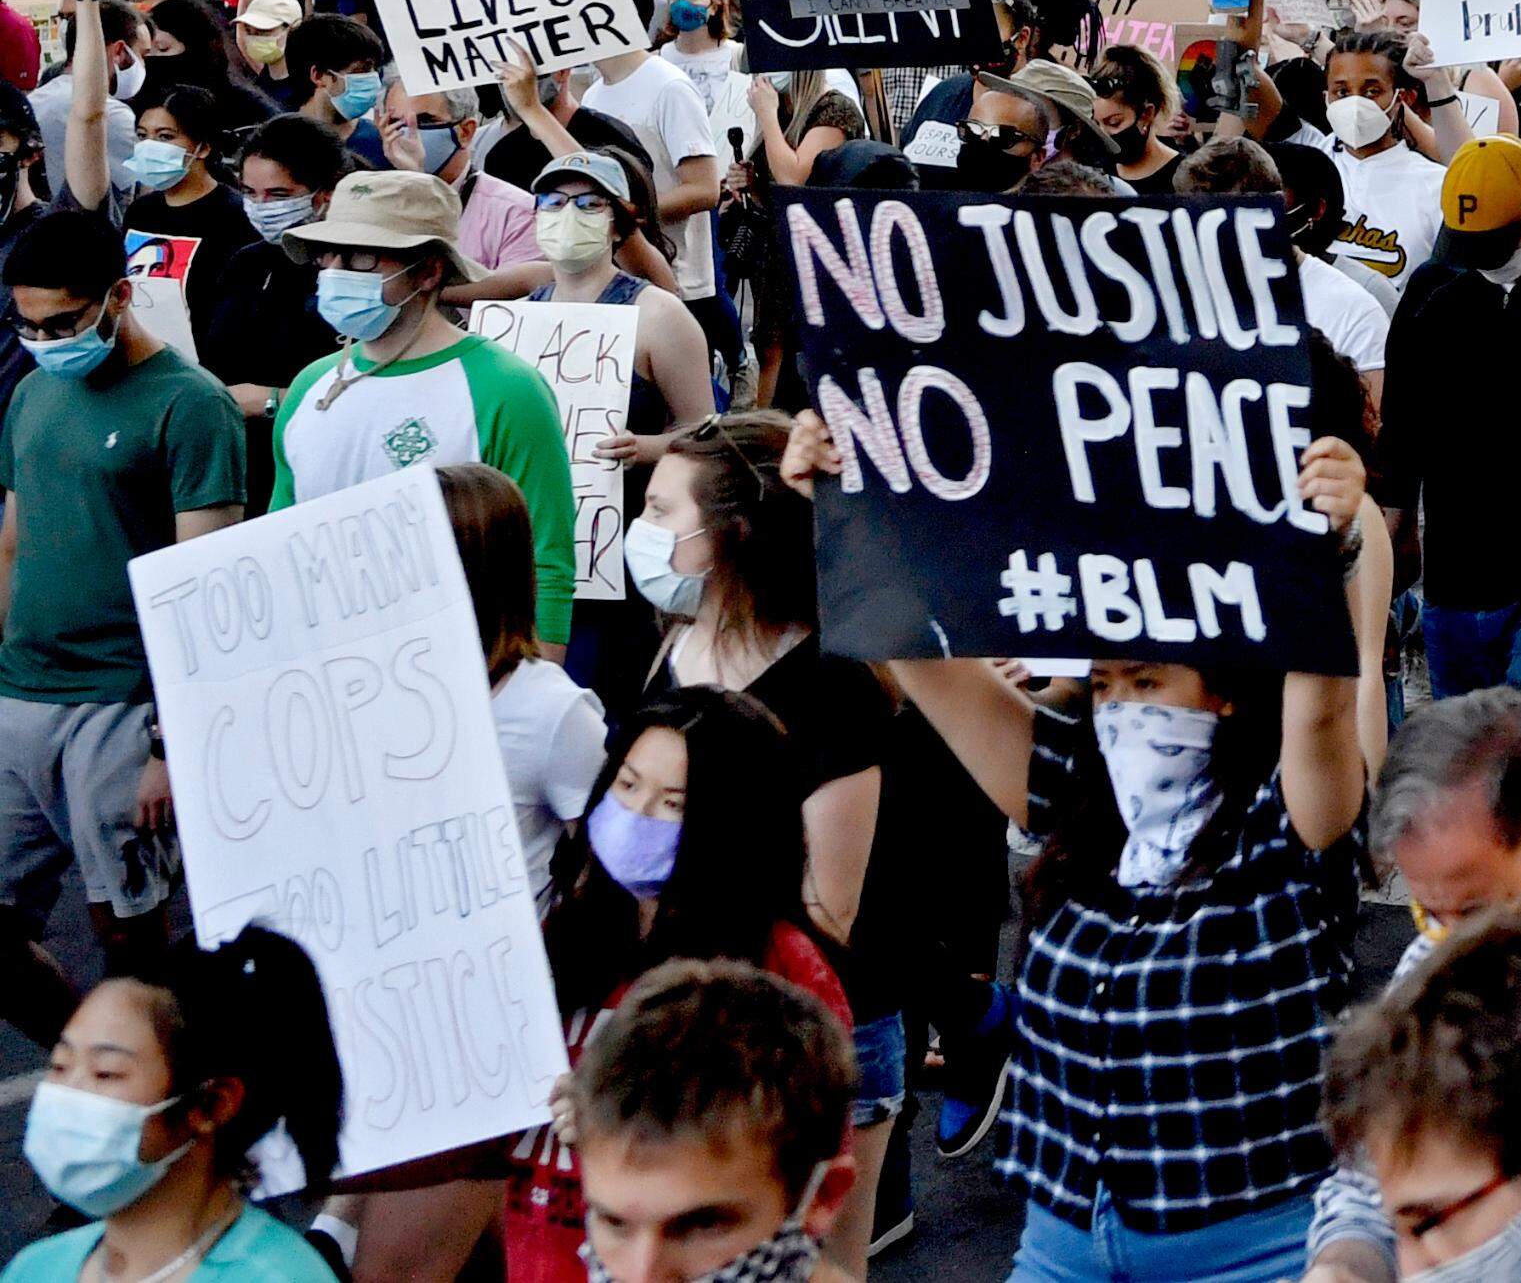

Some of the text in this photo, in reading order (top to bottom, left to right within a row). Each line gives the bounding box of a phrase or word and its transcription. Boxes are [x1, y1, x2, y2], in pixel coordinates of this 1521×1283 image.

[421, 2, 631, 86] MATTER
[786, 198, 1301, 351] NO JUSTICE
[817, 361, 1330, 534] NO PEACE
[996, 549, 1269, 644] #BLM
[204, 635, 457, 842] COPS
